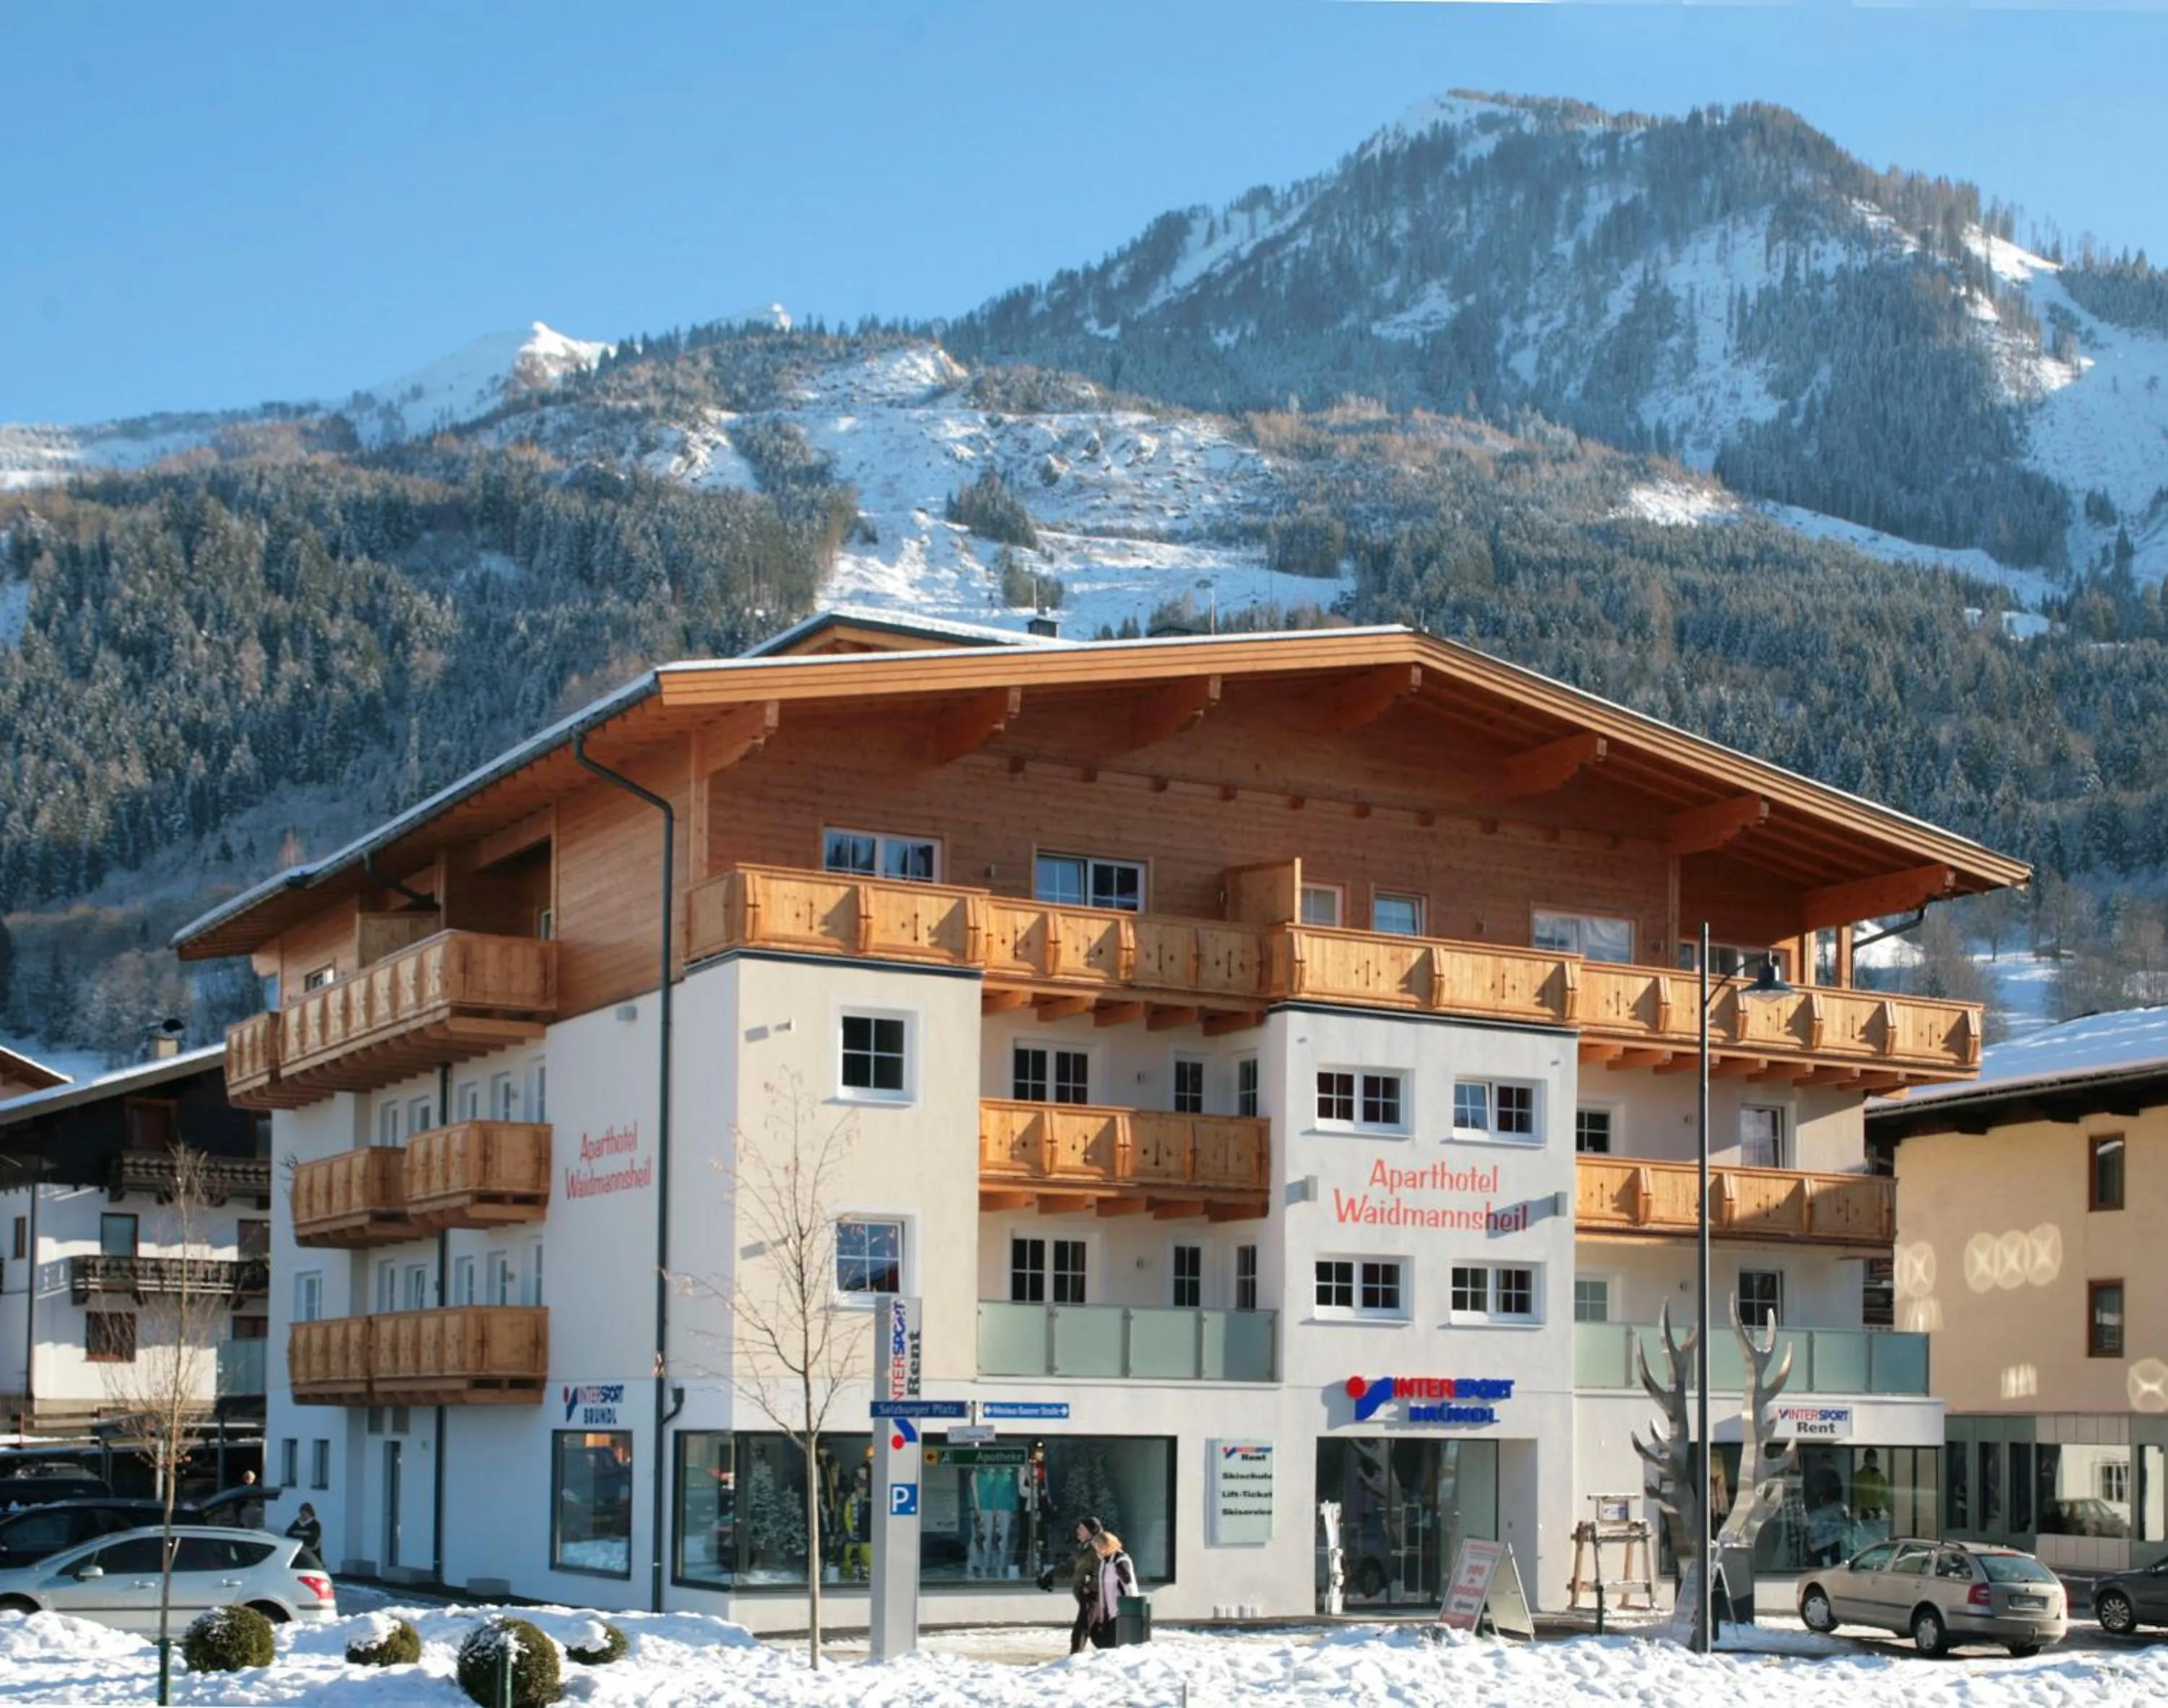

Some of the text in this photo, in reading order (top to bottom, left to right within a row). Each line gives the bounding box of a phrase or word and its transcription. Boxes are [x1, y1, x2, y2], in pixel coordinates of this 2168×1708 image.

[580, 1121, 637, 1167] Aparthotel
[1369, 1159, 1500, 1194] Aparthotel
[1334, 1189, 1527, 1232] Waidmannsheil
[892, 1301, 906, 1400] NTERSPORT
[908, 1329, 920, 1394] Rent
[879, 1404, 956, 1416] Salzburger Platz
[1789, 1410, 1848, 1421] INTERSPORT
[1797, 1421, 1836, 1433] Rent
[976, 1452, 1023, 1464] Apotheke
[892, 1486, 908, 1513] P
